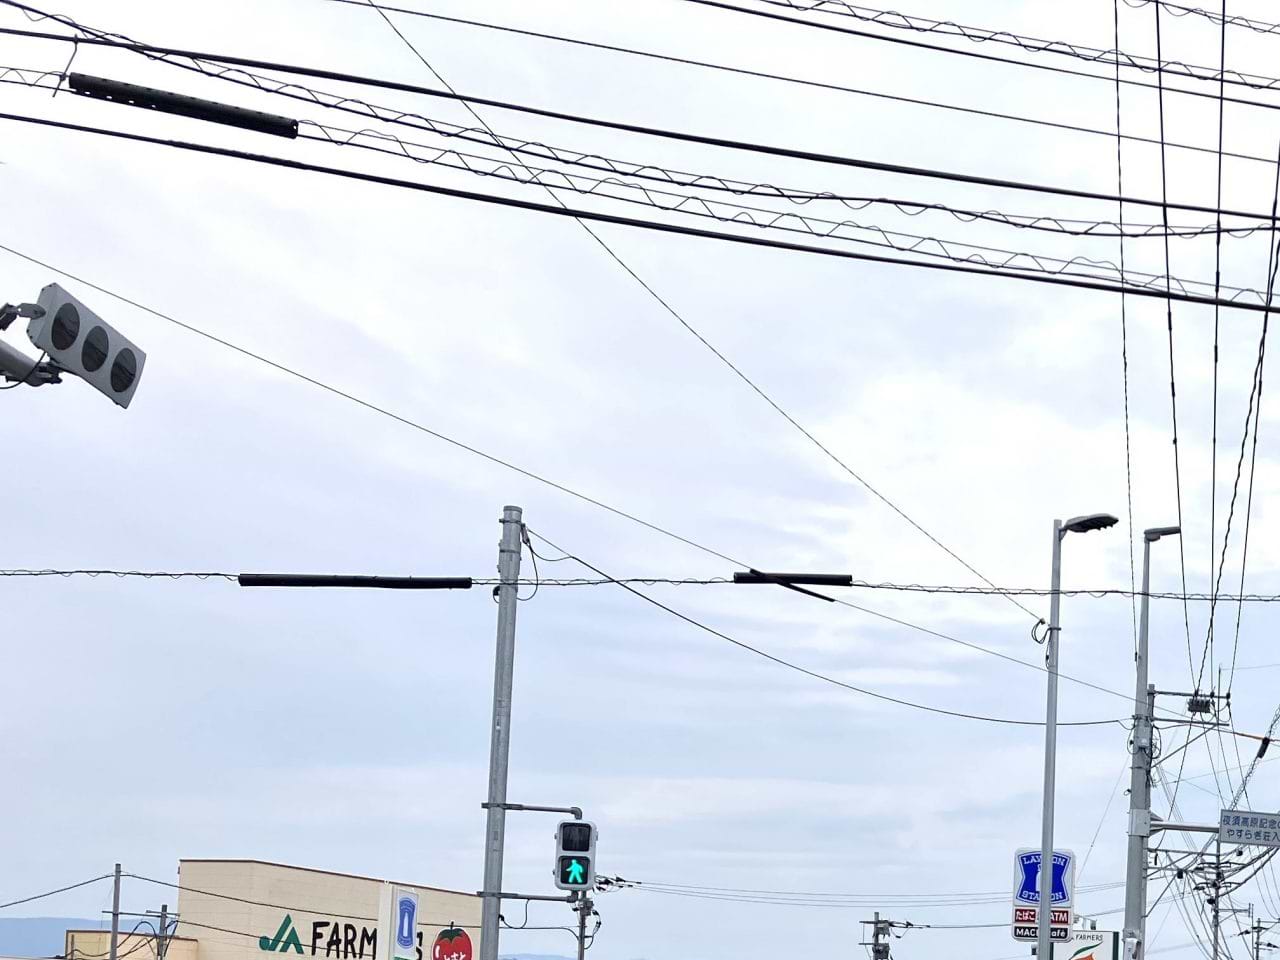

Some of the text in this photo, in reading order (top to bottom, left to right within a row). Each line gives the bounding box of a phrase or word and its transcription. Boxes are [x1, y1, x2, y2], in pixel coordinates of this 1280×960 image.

[1022, 855, 1066, 866] LAWON
[1021, 890, 1063, 900] STAON
[1015, 910, 1036, 921] たばこ
